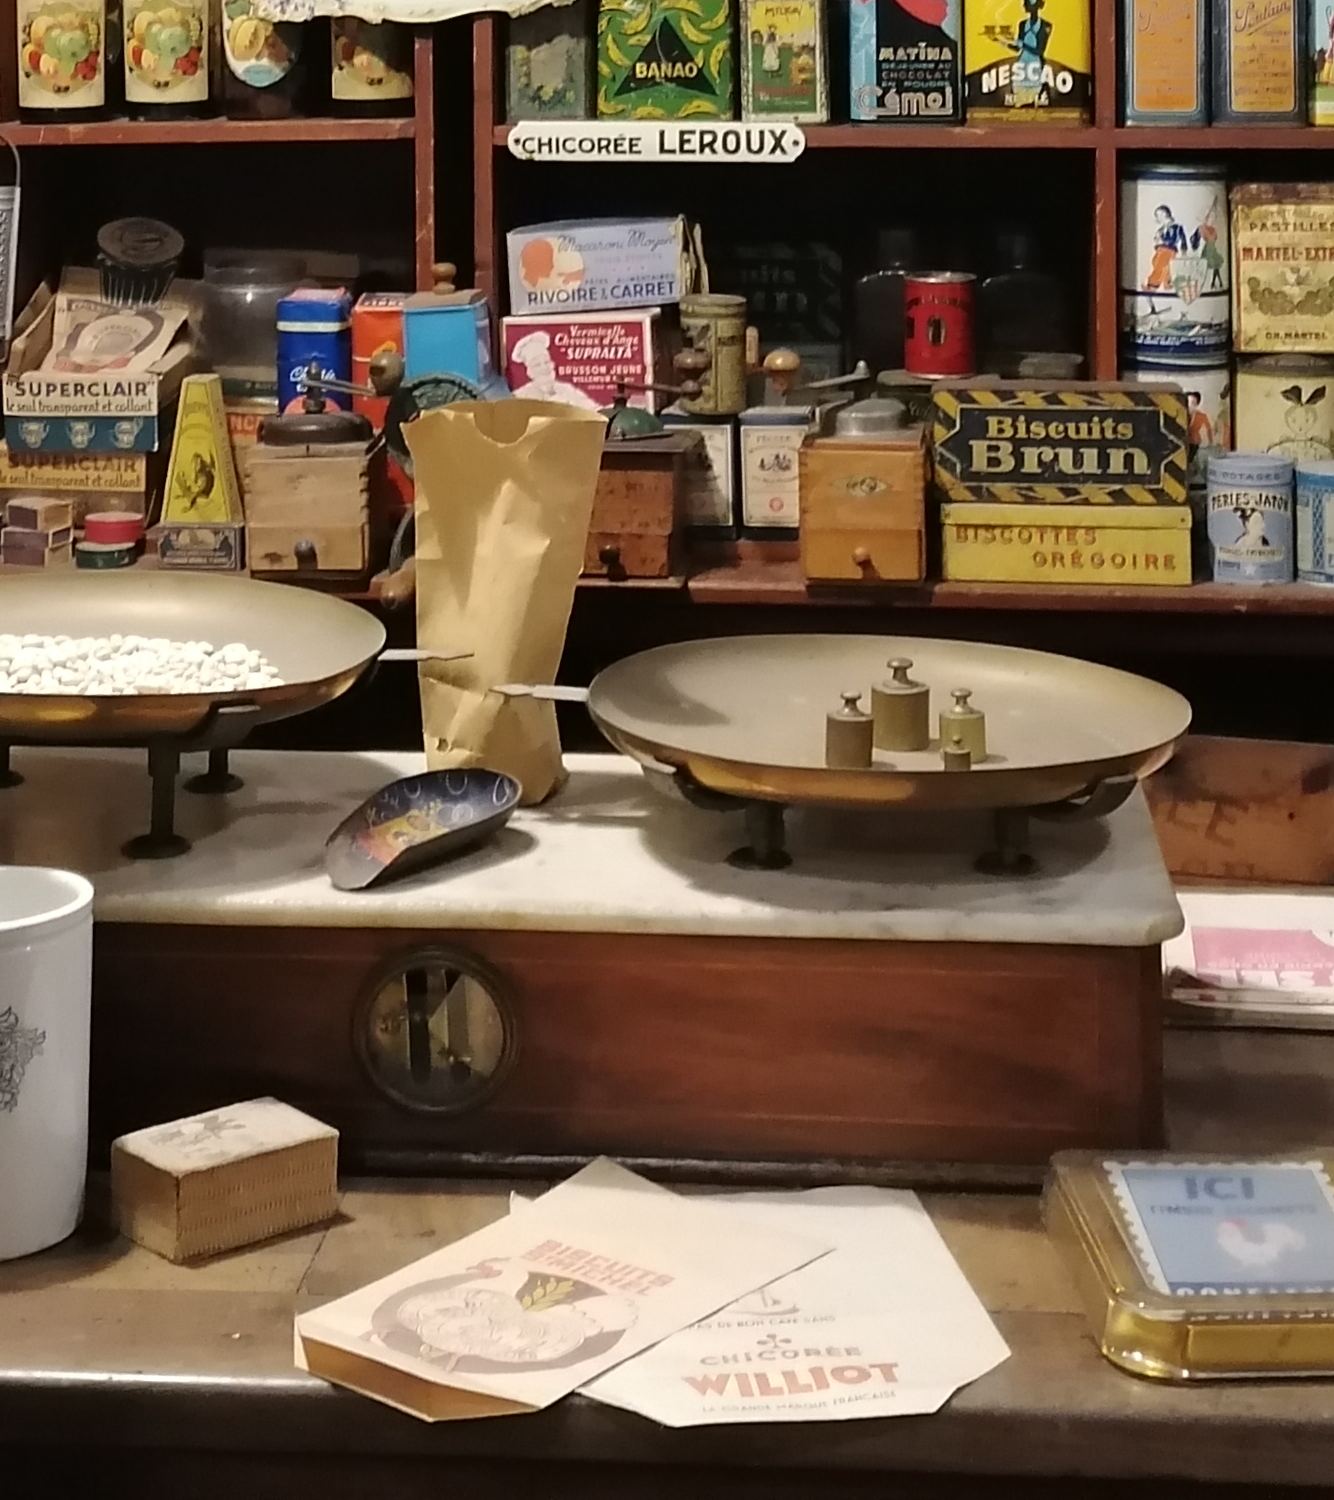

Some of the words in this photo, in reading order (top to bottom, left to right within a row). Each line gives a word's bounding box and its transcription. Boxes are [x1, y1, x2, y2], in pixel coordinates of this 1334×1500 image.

[635, 61, 699, 80] BANAO
[981, 61, 1074, 95] NESCAO
[521, 135, 643, 155] CHICORÉE
[658, 129, 788, 156] LEROUX
[528, 287, 598, 306] RIVOIRE
[610, 280, 676, 300] CARRET
[558, 365, 608, 377] BRUSSON
[610, 364, 643, 375] JEUNE
[6, 399, 14, 412] le
[38, 400, 99, 415] transparent
[102, 402, 111, 411] et
[115, 399, 152, 412] collant
[985, 414, 1135, 442] Biscuits
[967, 438, 1152, 477] Brun
[953, 524, 1098, 546] BISCOTTES
[1031, 547, 1178, 572] GRÉGOIRE
[1184, 1176, 1256, 1200] ICI
[699, 1346, 862, 1366] CHICORÉE
[681, 1362, 900, 1398] WILLIOT
